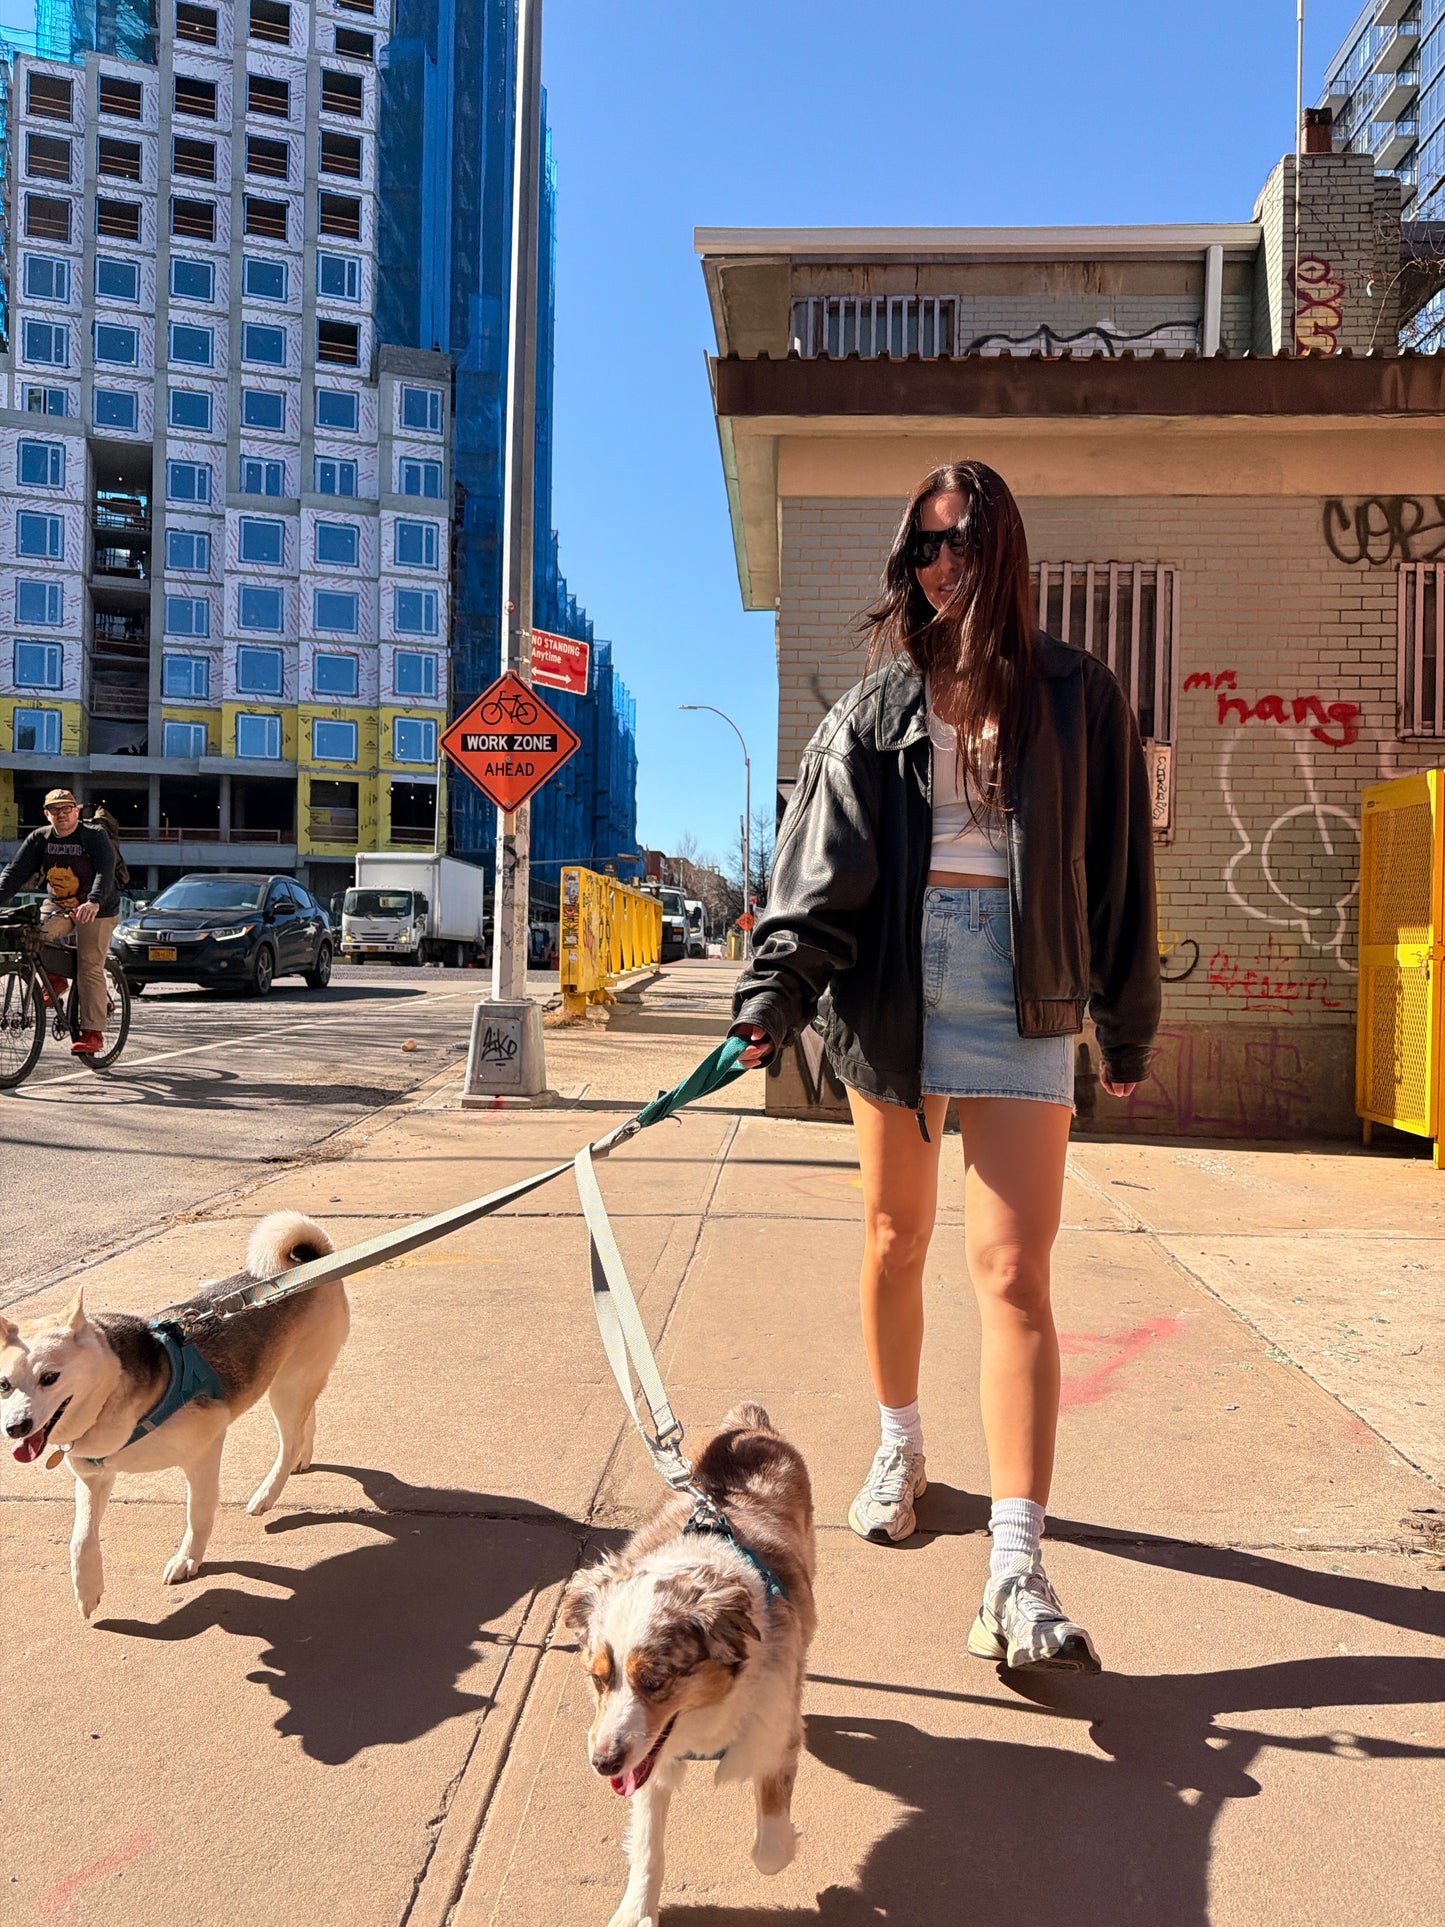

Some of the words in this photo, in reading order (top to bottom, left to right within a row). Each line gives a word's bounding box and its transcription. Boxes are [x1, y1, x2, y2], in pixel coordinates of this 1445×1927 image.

[531, 635, 543, 646] NO
[544, 638, 580, 657] STANDING
[531, 648, 562, 664] Anytime
[467, 735, 508, 751] WORK
[513, 735, 552, 751] ZONE
[484, 762, 535, 777] AHEAD
